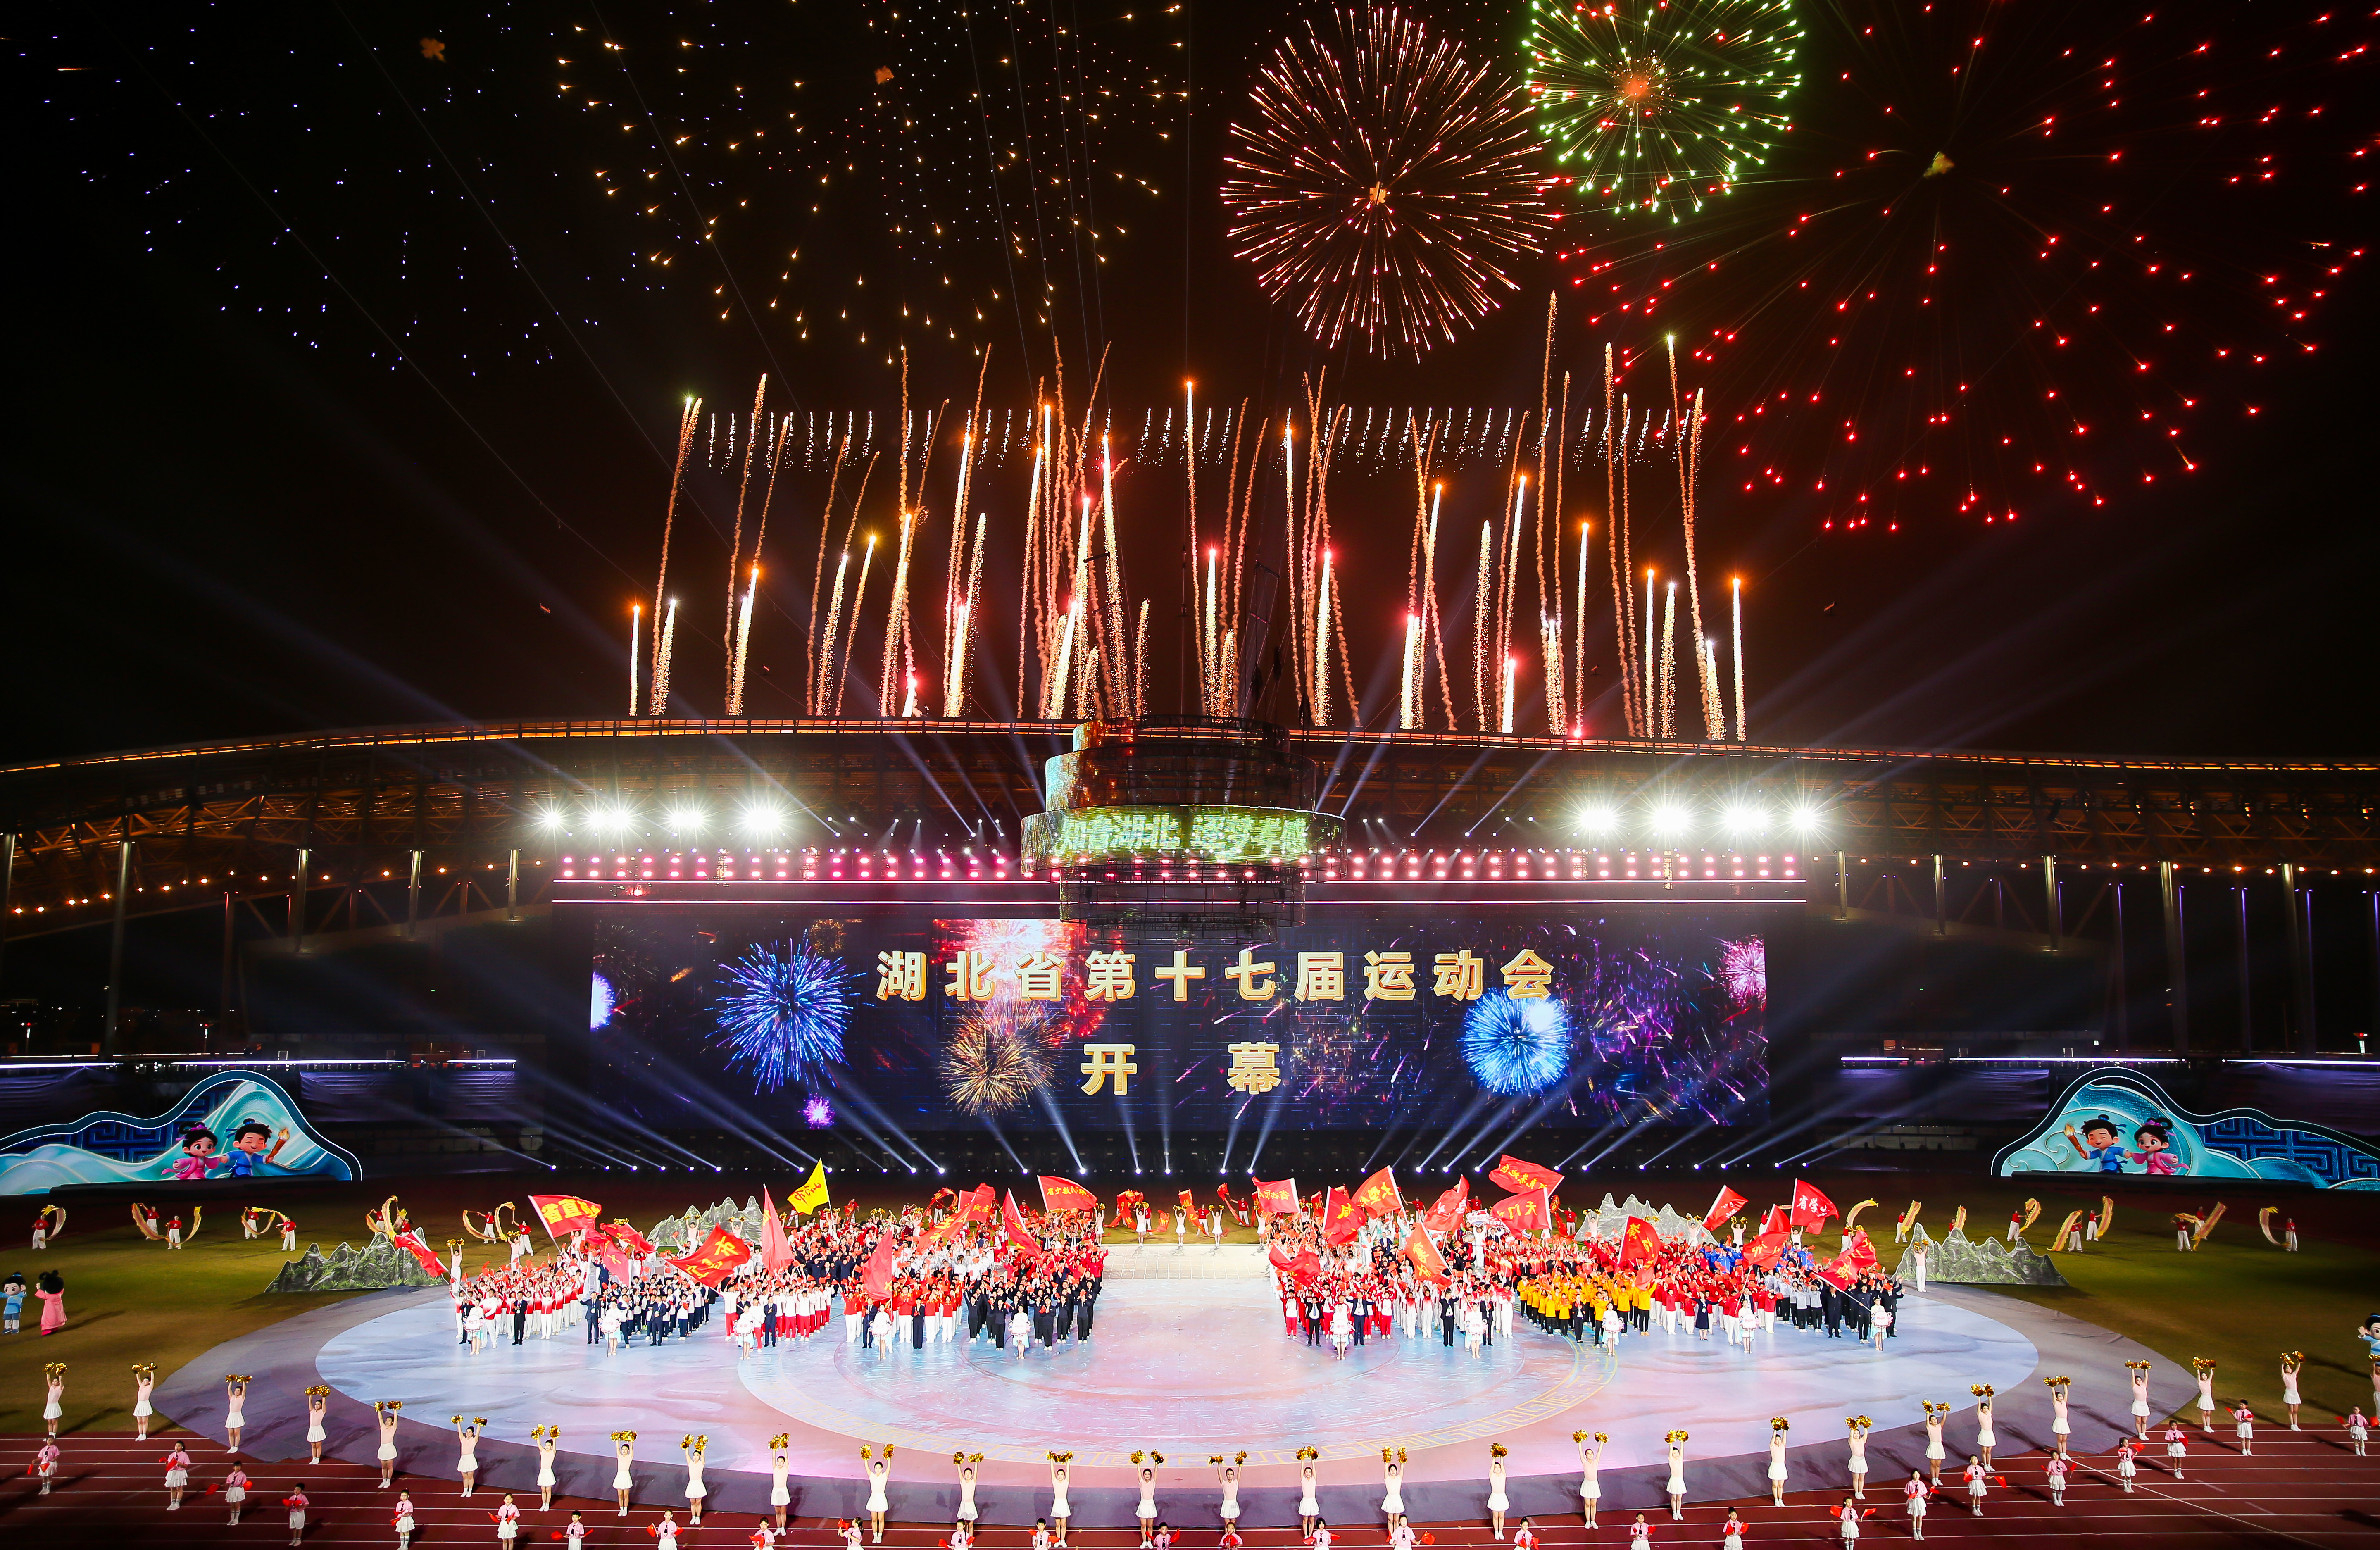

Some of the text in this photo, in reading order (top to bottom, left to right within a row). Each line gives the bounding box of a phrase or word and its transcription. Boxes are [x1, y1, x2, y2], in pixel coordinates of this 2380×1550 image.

[876, 949, 1555, 1002] 湖北省第十七届运动会
[1081, 1041, 1281, 1095] 开幕
